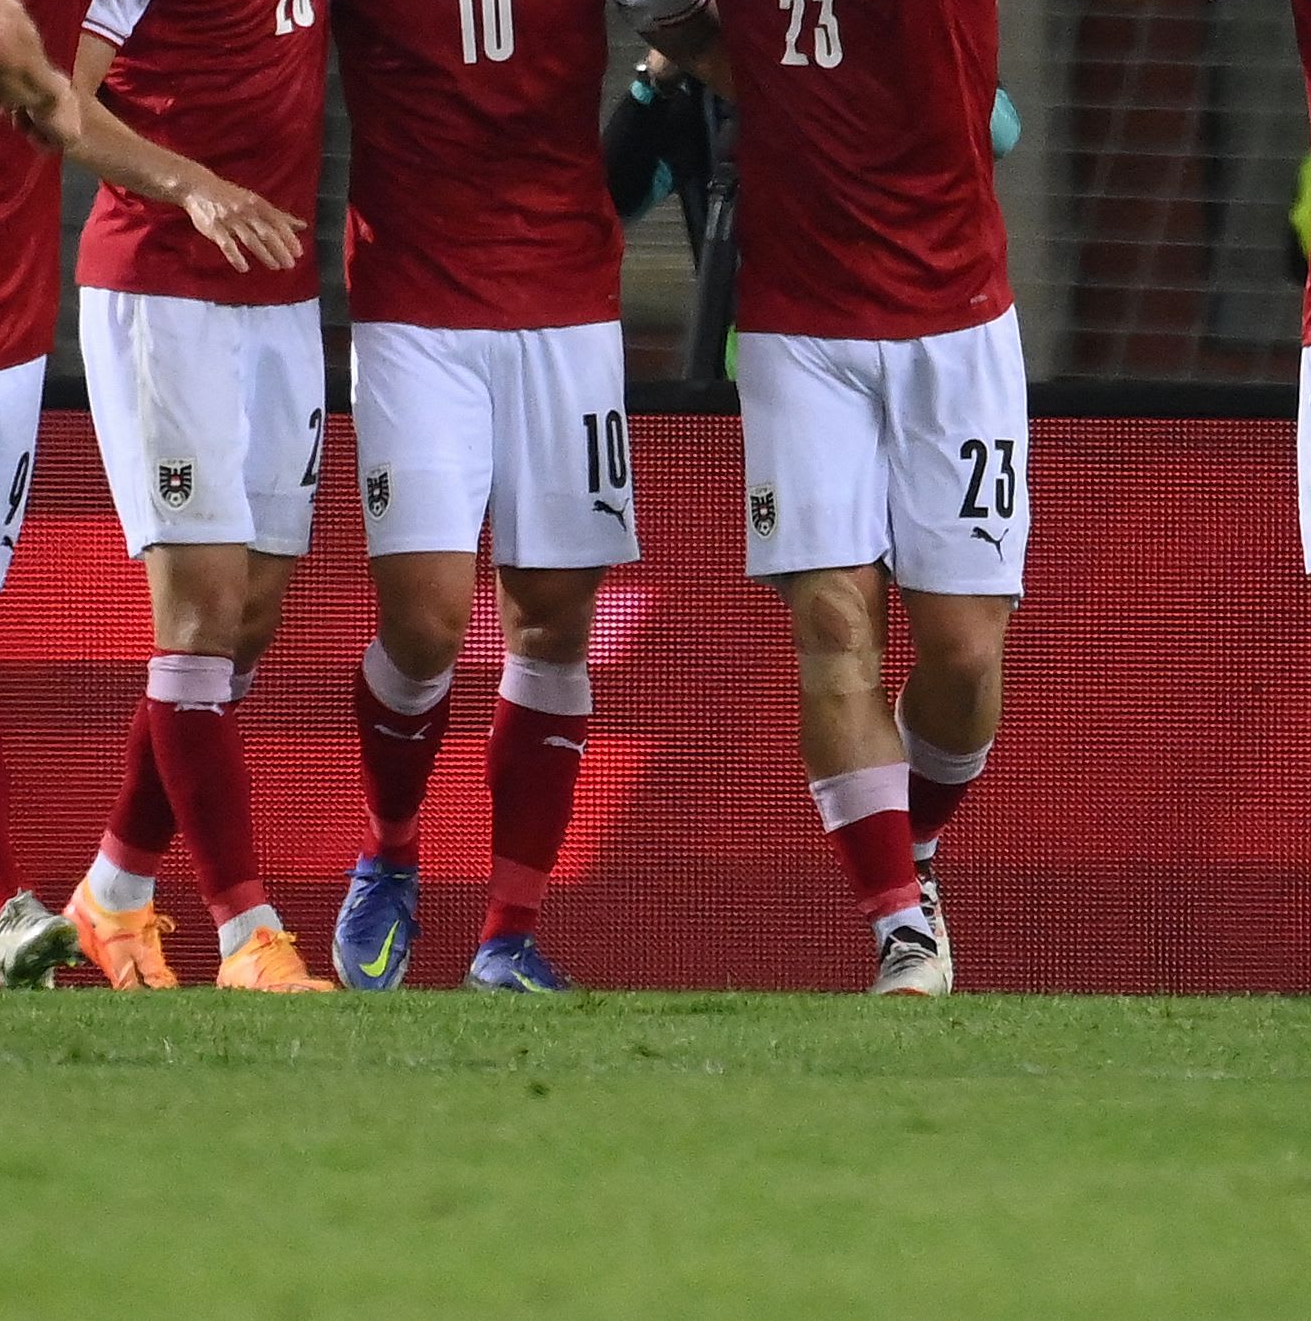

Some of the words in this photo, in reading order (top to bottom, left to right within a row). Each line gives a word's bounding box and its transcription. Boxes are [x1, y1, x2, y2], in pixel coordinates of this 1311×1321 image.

[5, 451, 30, 525] 9
[583, 409, 627, 493] 10
[959, 438, 1016, 519] 23
